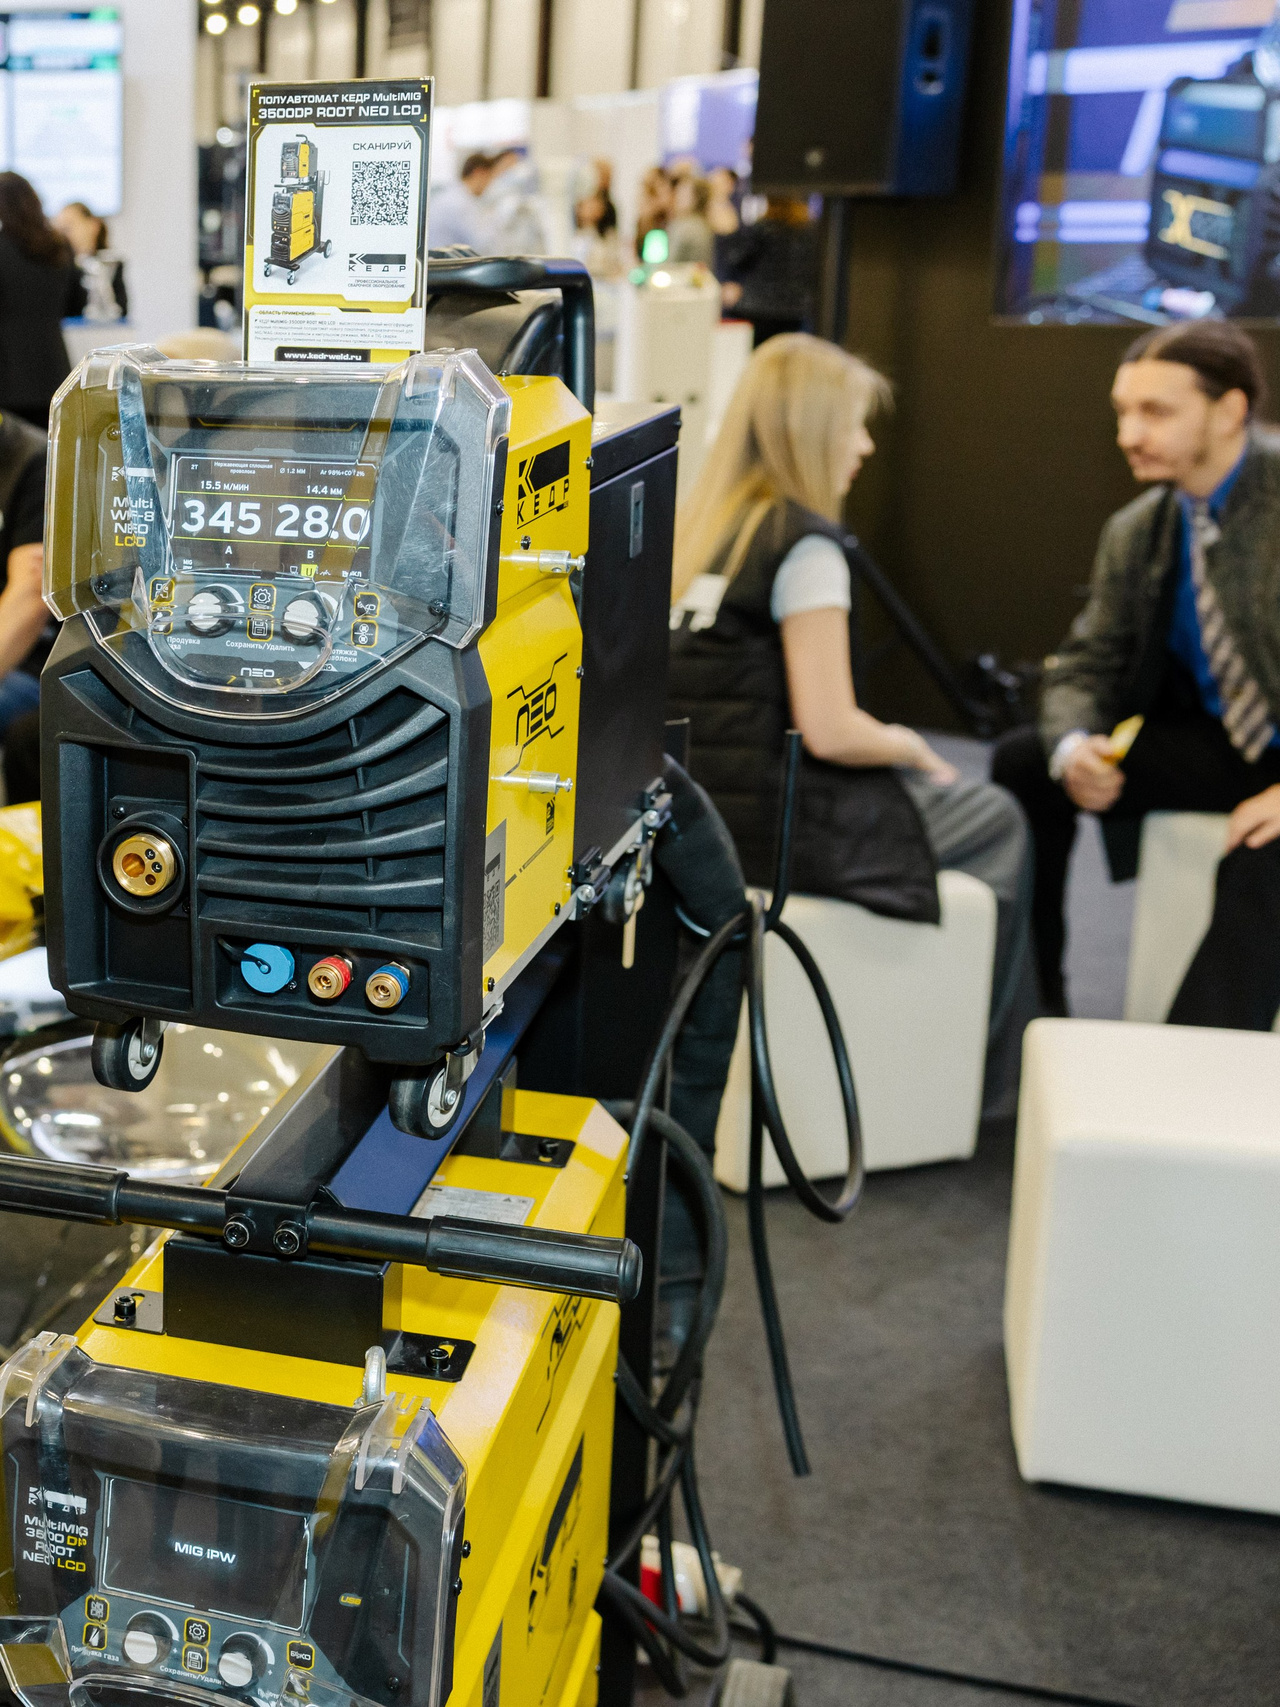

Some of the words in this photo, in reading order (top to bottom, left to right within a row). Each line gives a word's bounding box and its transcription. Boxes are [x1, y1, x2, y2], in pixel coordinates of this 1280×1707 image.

[258, 94, 339, 105] ПОЛУАВТОМАТ
[341, 93, 370, 103] КЕДР
[258, 107, 313, 119] 3500DP
[316, 106, 355, 118] ROOT
[358, 105, 389, 117] NEO
[393, 104, 421, 116] LCD
[352, 140, 412, 151] СКАНИРУЙ
[284, 351, 362, 361] www.kedrweld.ru
[200, 480, 221, 490] 15.5
[306, 484, 328, 495] 14.4
[113, 496, 153, 509] Multi
[517, 478, 569, 525] КЕДР
[181, 499, 261, 536] 345
[275, 503, 369, 541] 28.0
[114, 522, 149, 534] NEO
[115, 535, 146, 547] LCD
[167, 636, 200, 645] Продувка
[225, 640, 295, 652] Сохранить/Удалить
[24, 1514, 89, 1537] MultiMIG
[35, 1541, 75, 1558] ROOT
[174, 1541, 203, 1557] MIG
[206, 1548, 236, 1564] iPW
[23, 1550, 55, 1566] NEO
[57, 1557, 87, 1572] LCD
